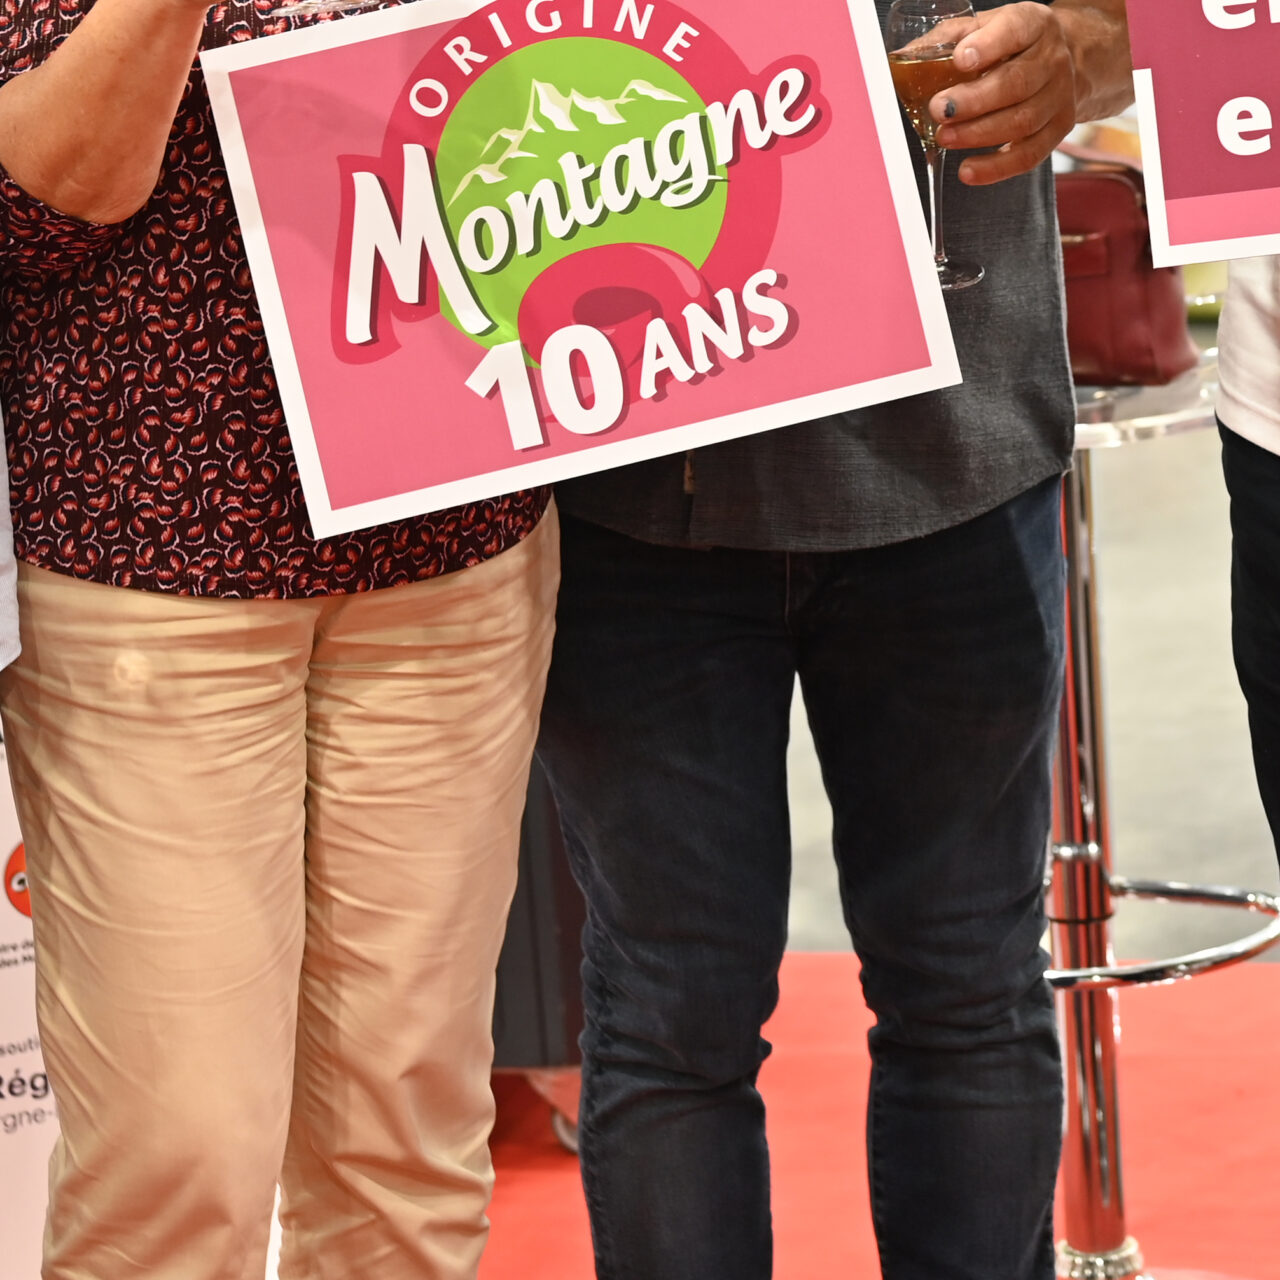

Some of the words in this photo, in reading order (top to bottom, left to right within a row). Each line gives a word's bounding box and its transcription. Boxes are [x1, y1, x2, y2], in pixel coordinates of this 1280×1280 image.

[345, 67, 817, 345] Montagne
[464, 323, 625, 451] 10
[639, 268, 790, 399] ANS
